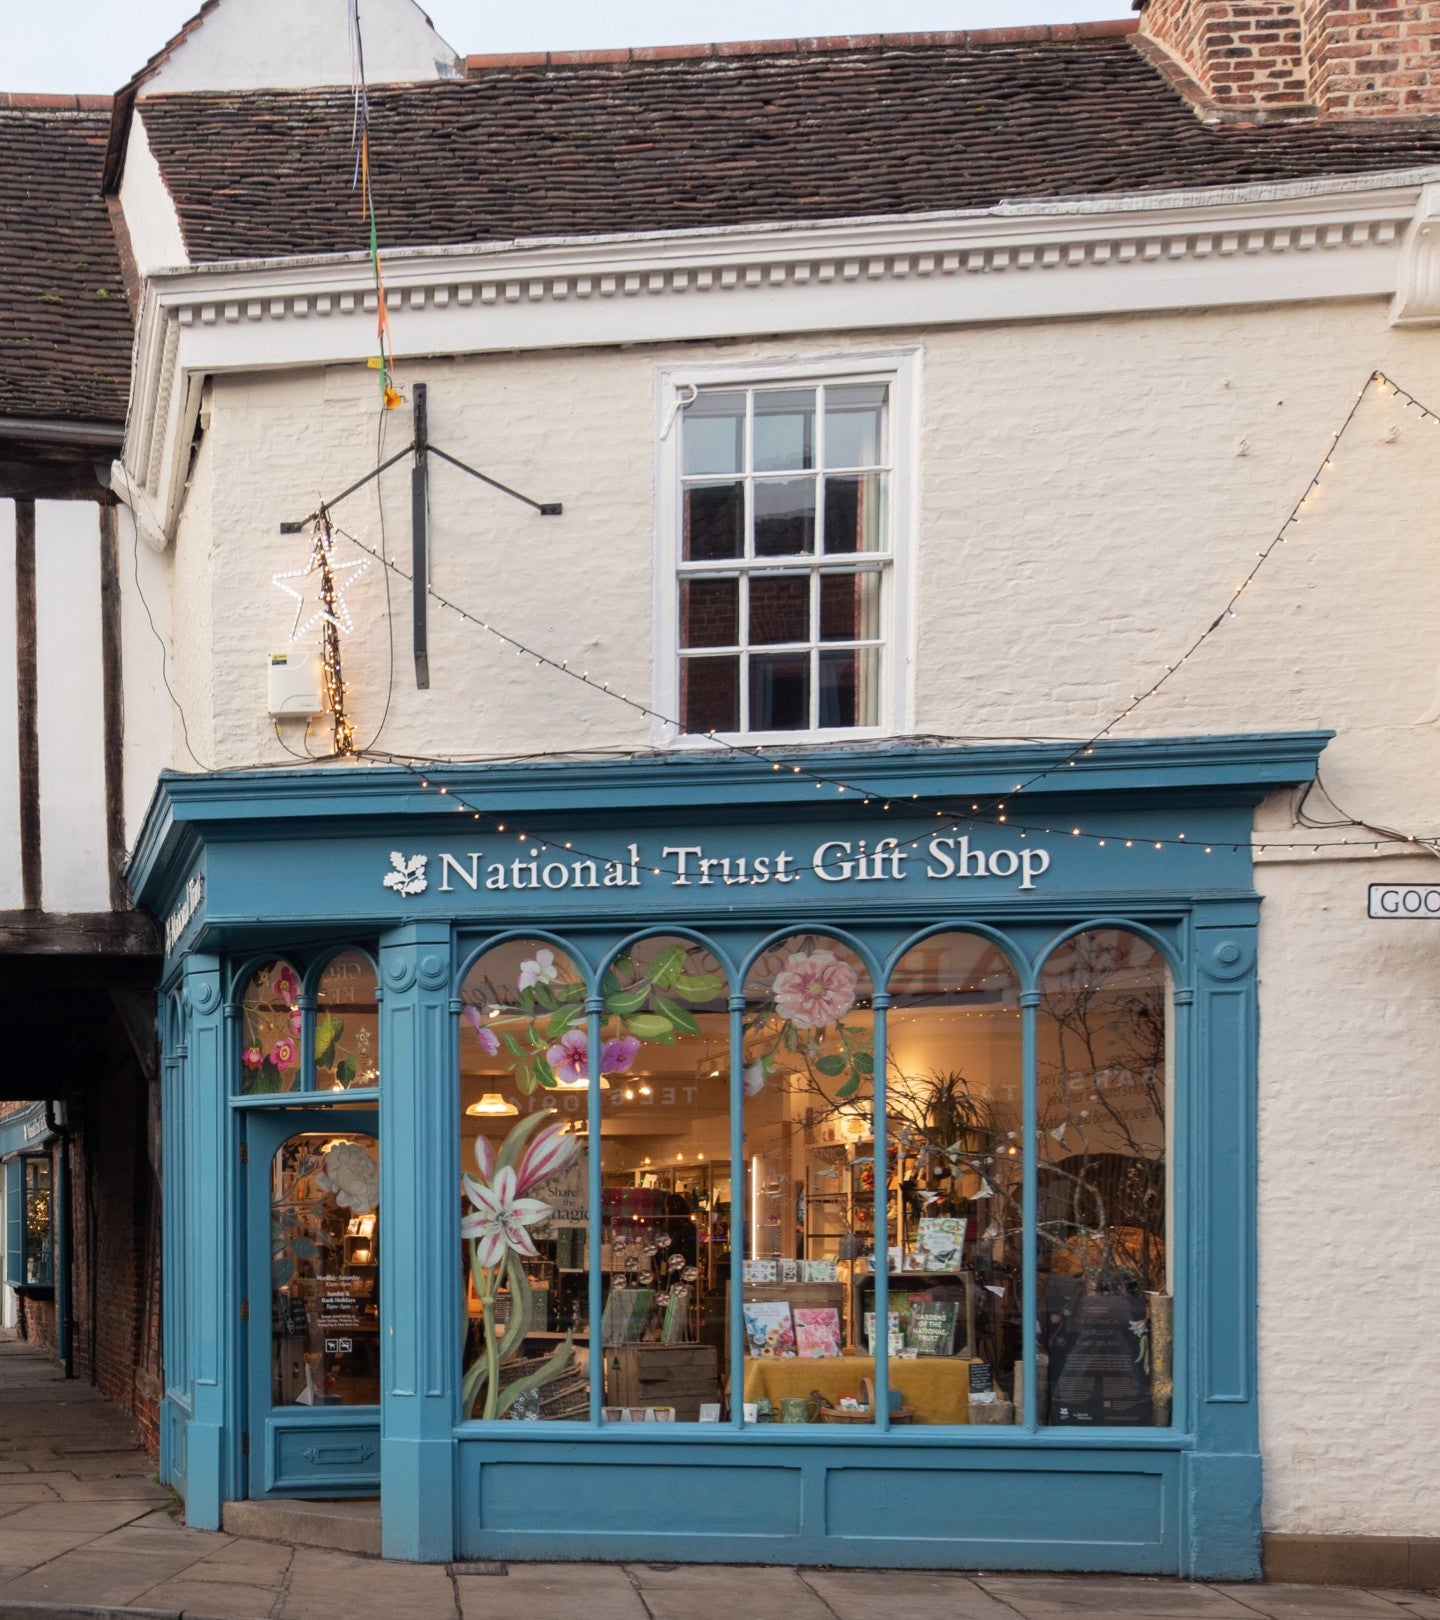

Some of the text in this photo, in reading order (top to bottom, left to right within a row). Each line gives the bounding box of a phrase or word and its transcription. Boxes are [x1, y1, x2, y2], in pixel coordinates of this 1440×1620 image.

[438, 836, 1051, 891] National Trust Gift Shop
[548, 1186, 578, 1197] Share
[562, 1199, 576, 1207] the
